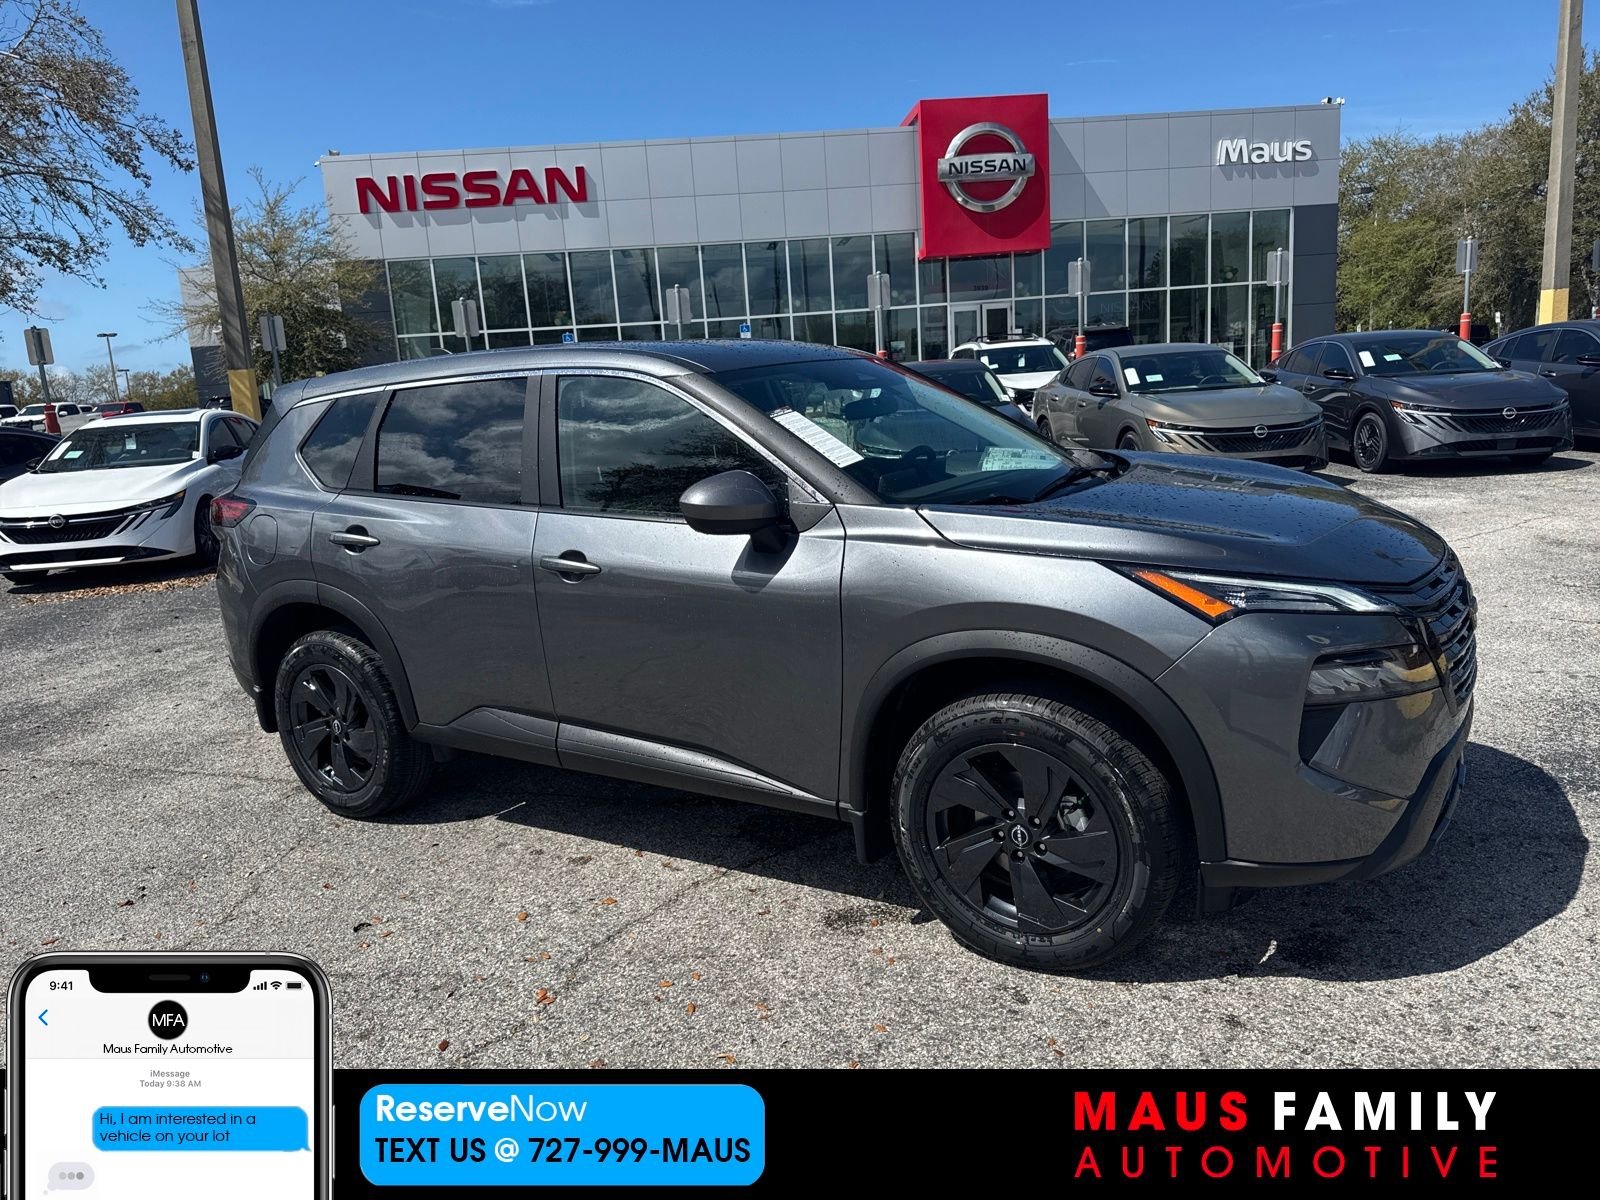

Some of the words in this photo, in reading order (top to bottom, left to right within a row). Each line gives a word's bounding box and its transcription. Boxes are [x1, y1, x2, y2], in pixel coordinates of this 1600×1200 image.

[1216, 138, 1312, 165] Maus
[948, 158, 1026, 175] NISSAN
[355, 166, 588, 214] NISSAN
